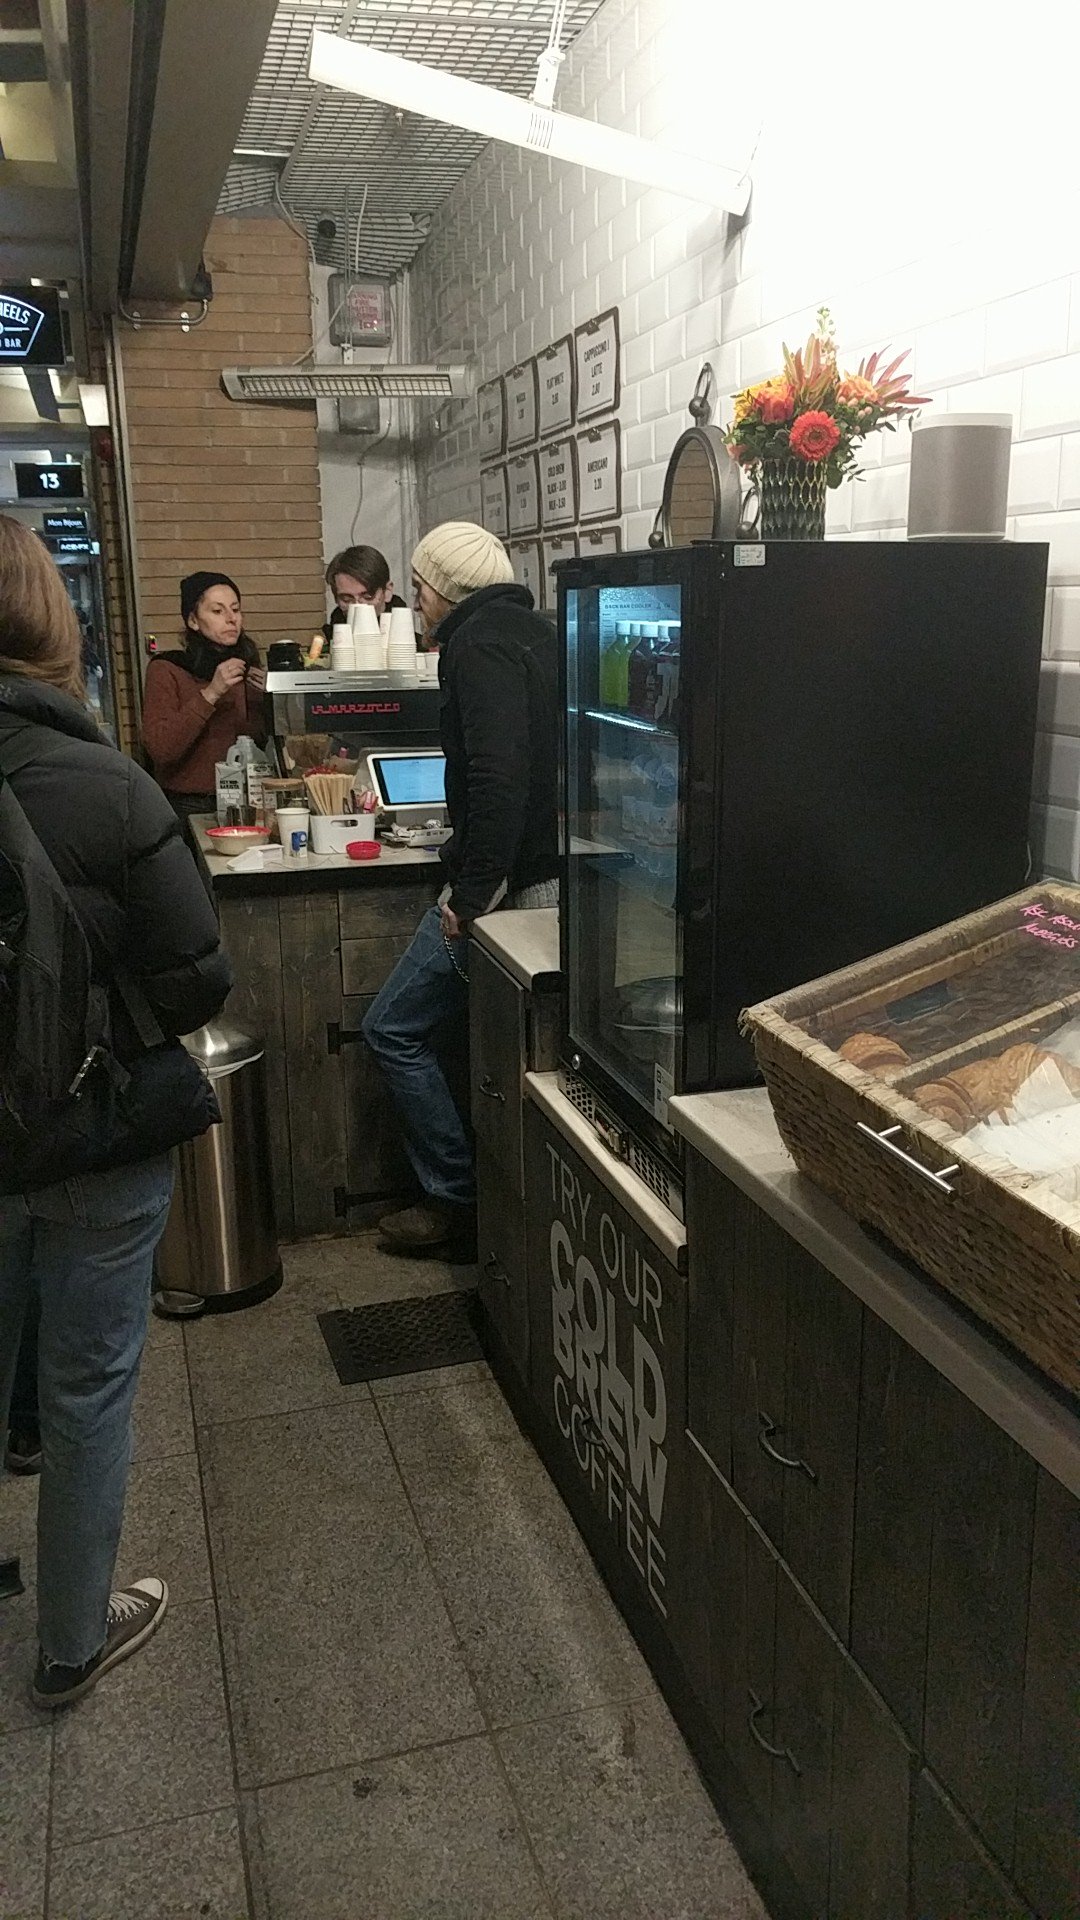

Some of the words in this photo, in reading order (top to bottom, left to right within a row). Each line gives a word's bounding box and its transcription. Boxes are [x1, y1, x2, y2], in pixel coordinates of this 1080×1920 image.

[4, 338, 22, 348] BAR
[584, 340, 607, 363] CAPPUCCINO
[592, 362, 603, 378] LATTE
[588, 457, 608, 473] AMERICANO
[39, 472, 60, 489] 13
[546, 1141, 592, 1242] TRY
[600, 1213, 665, 1346] OUR
[550, 1219, 667, 1445] COLD
[551, 1284, 668, 1529] BREW
[554, 1374, 668, 1620] COFFEE
